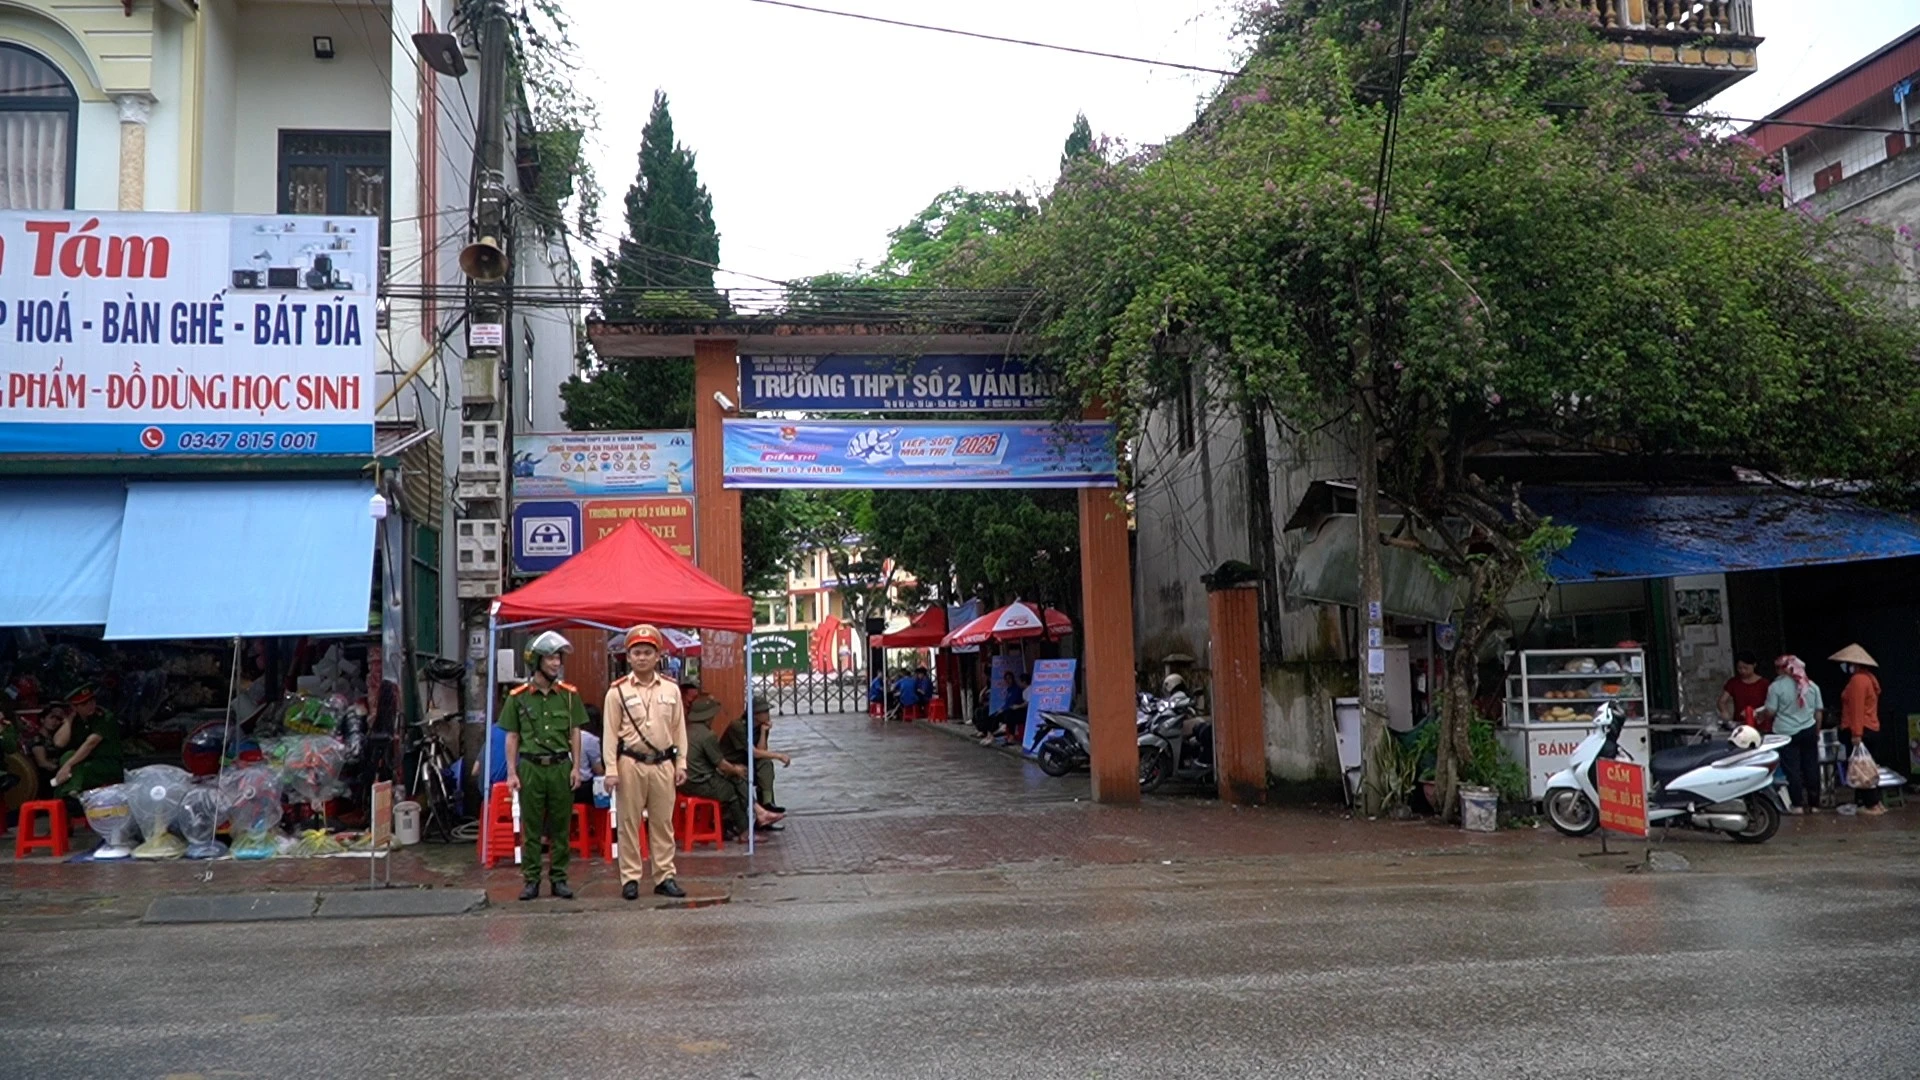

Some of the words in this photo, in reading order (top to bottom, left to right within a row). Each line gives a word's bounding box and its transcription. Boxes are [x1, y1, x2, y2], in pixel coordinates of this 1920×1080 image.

[25, 217, 171, 279] Tám
[16, 291, 73, 343] HOÁ
[102, 292, 161, 345] BÀN
[170, 289, 227, 346] GHẾ
[254, 294, 307, 346] BÁT
[315, 296, 362, 347] ĐĨA
[8, 356, 87, 410] PHẨM
[106, 361, 147, 411] ĐỒ
[152, 367, 227, 411] DÙNG
[232, 374, 291, 417] HỌC
[296, 374, 360, 411] SINH
[752, 371, 845, 398] TRƯỜNG
[850, 374, 907, 398] THPT
[913, 365, 944, 398] SỐ
[947, 374, 962, 397] 2
[968, 368, 1015, 397] VĂN
[178, 432, 230, 449] 0347
[236, 432, 274, 449] 815
[280, 432, 318, 449] 001
[929, 448, 947, 456] THI
[956, 432, 1000, 455] 2025
[797, 453, 816, 462] THI
[1631, 793, 1642, 809] XE
